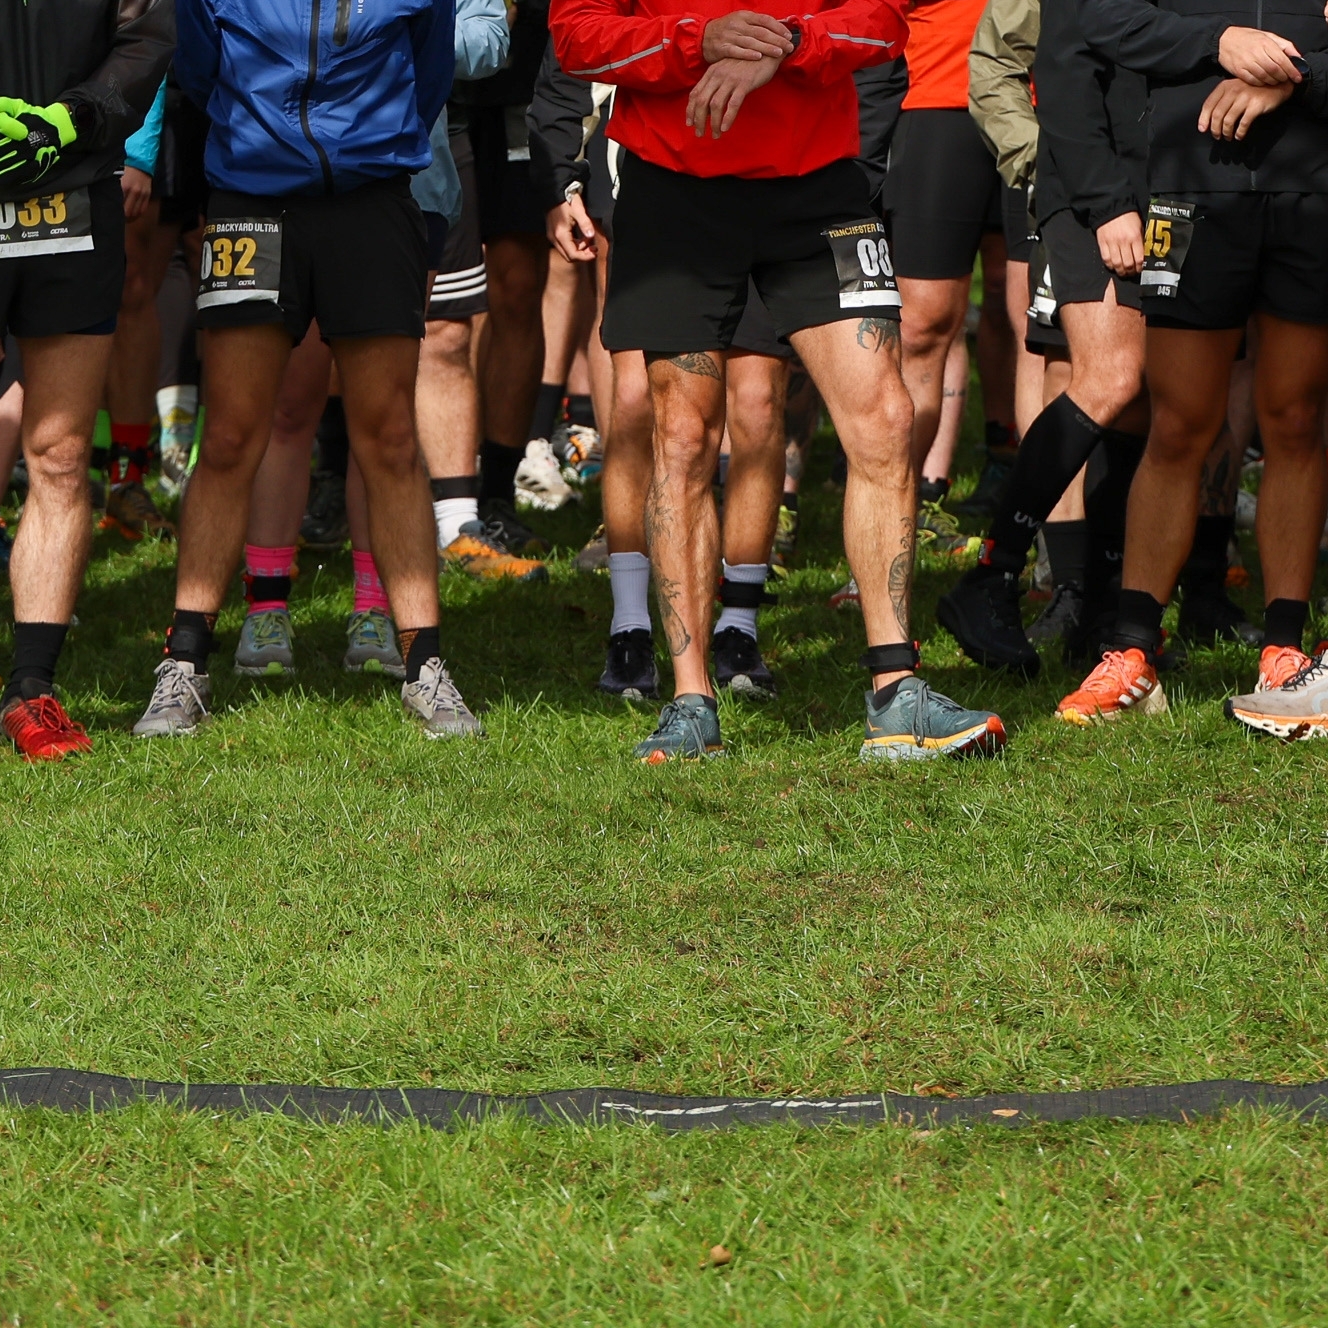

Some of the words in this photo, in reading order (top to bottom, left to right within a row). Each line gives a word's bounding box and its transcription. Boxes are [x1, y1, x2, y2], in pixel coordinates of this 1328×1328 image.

[216, 222, 254, 233] BACKYARD
[254, 222, 279, 233] ULTRA
[828, 223, 877, 238] MANCHESTER
[1157, 285, 1171, 296] 045
